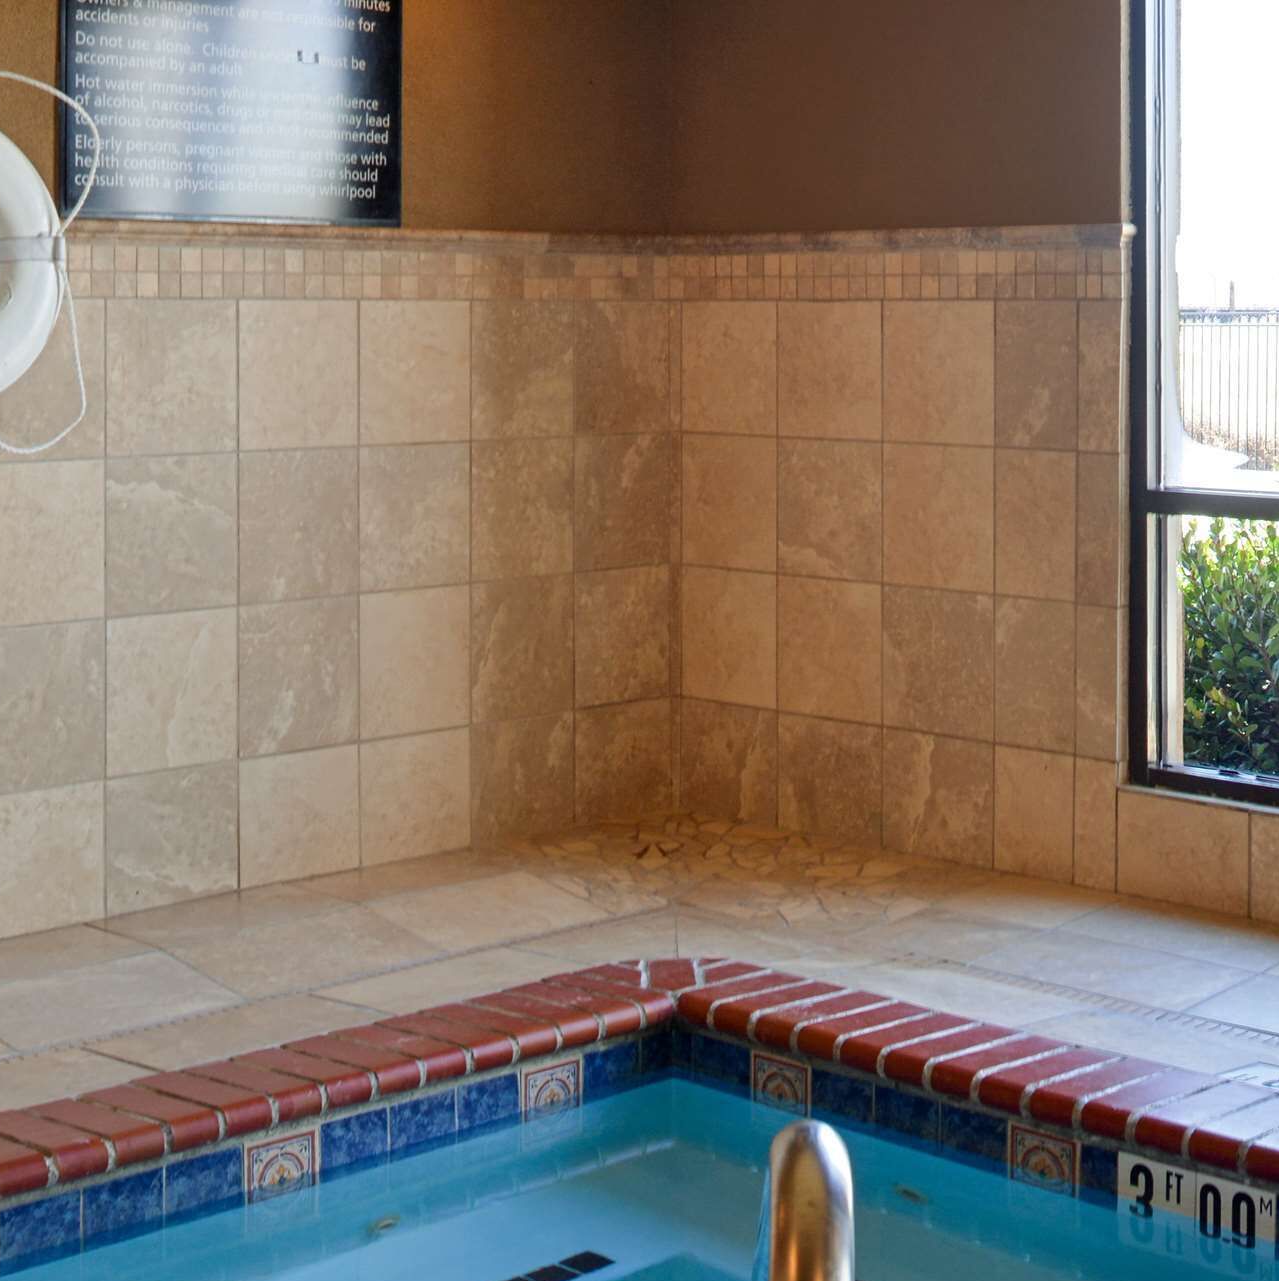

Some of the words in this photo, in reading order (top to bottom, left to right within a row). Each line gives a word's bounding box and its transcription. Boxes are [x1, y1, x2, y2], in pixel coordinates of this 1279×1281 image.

[75, 8, 139, 26] accidents
[161, 14, 209, 32] injuries
[147, 0, 234, 17] management
[358, 16, 377, 32] for
[344, 0, 391, 12] minutes
[75, 30, 96, 47] Do
[100, 35, 122, 49] not
[128, 38, 151, 51] use
[351, 55, 367, 72] be
[75, 51, 165, 70] accompanied
[169, 56, 185, 75] by
[189, 61, 205, 74] an
[75, 73, 101, 90] Hot
[105, 78, 145, 92] water
[150, 80, 217, 98] immersion
[94, 113, 142, 128] serious
[303, 127, 389, 145] recommended
[365, 113, 390, 128] lead
[75, 134, 122, 153] Elderly
[360, 152, 388, 166] with
[75, 153, 119, 169] health
[123, 155, 193, 173] conditions
[339, 166, 378, 183] should
[74, 172, 125, 188] consult
[129, 173, 160, 190] with
[175, 176, 234, 195] physician
[319, 182, 376, 201] whirlpool
[1129, 1163, 1154, 1218] 3
[1165, 1170, 1184, 1205] FT
[1260, 1196, 1273, 1217] M
